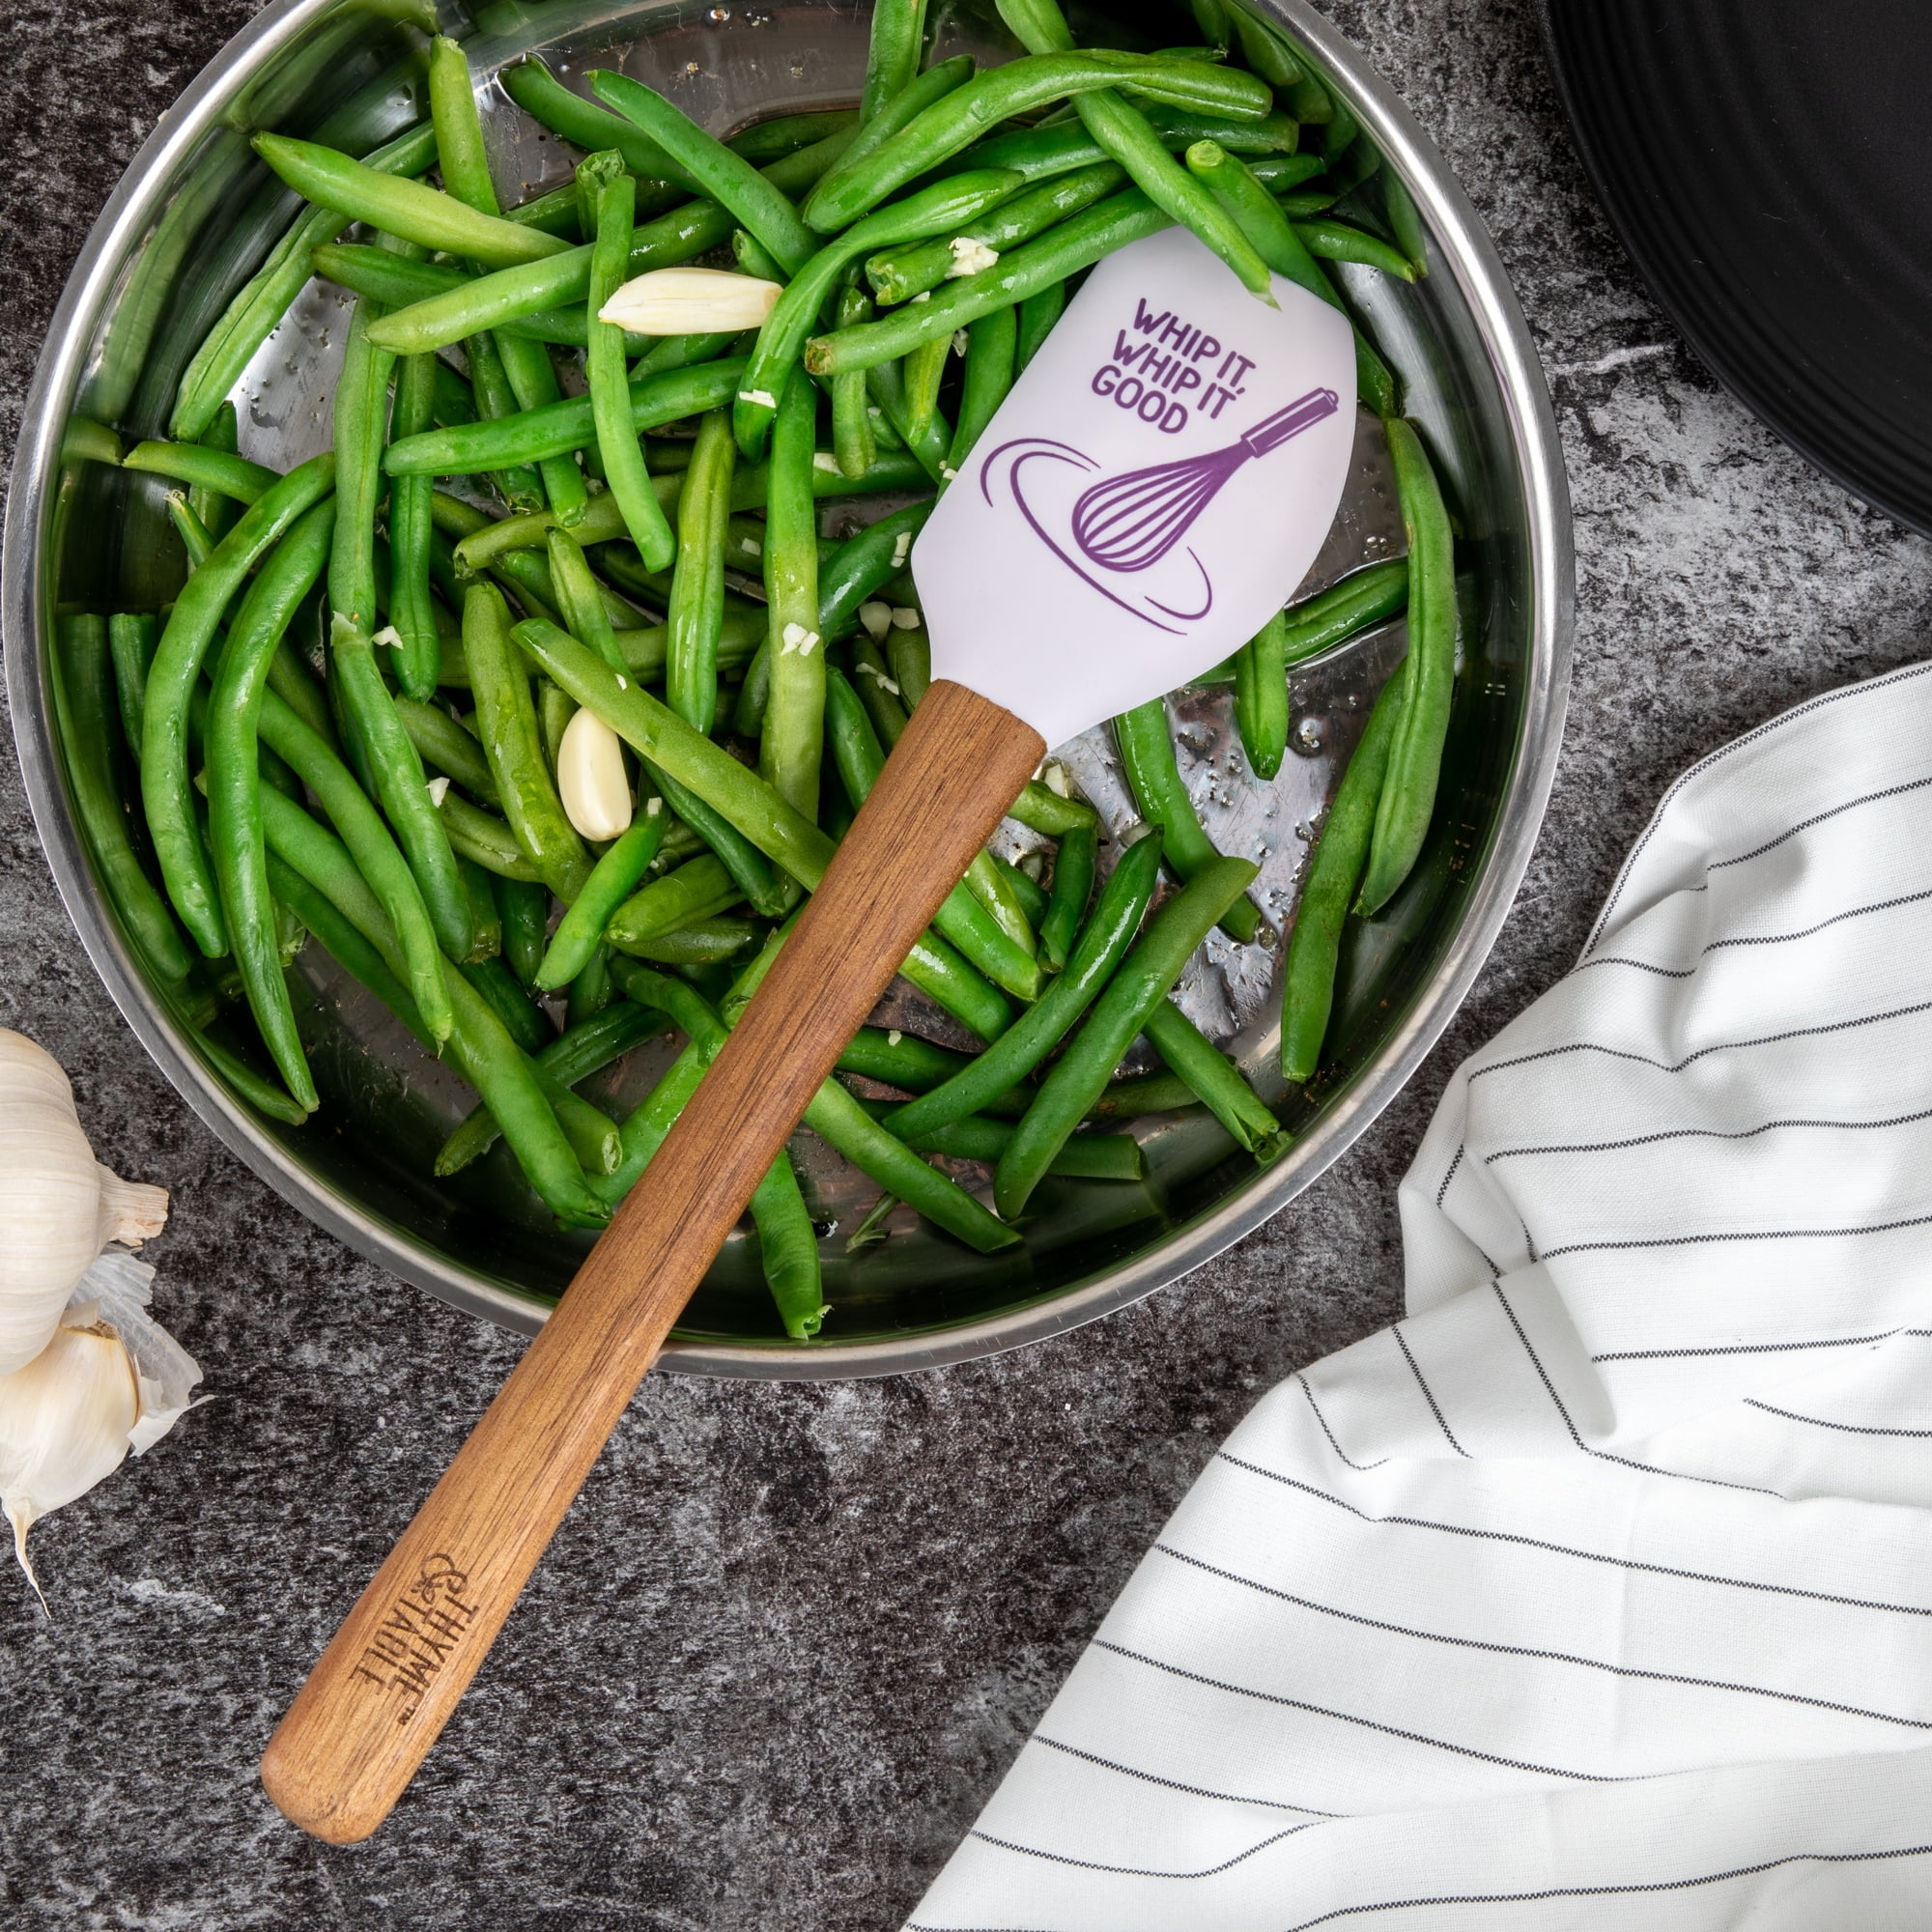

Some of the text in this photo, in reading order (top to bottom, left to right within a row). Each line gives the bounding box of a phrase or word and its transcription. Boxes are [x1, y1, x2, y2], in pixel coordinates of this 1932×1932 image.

[1133, 298, 1221, 363] WHIP
[1091, 364, 1188, 434] GOOD
[1113, 329, 1237, 419] WHIP IT
[349, 1597, 436, 1695] TABLE
